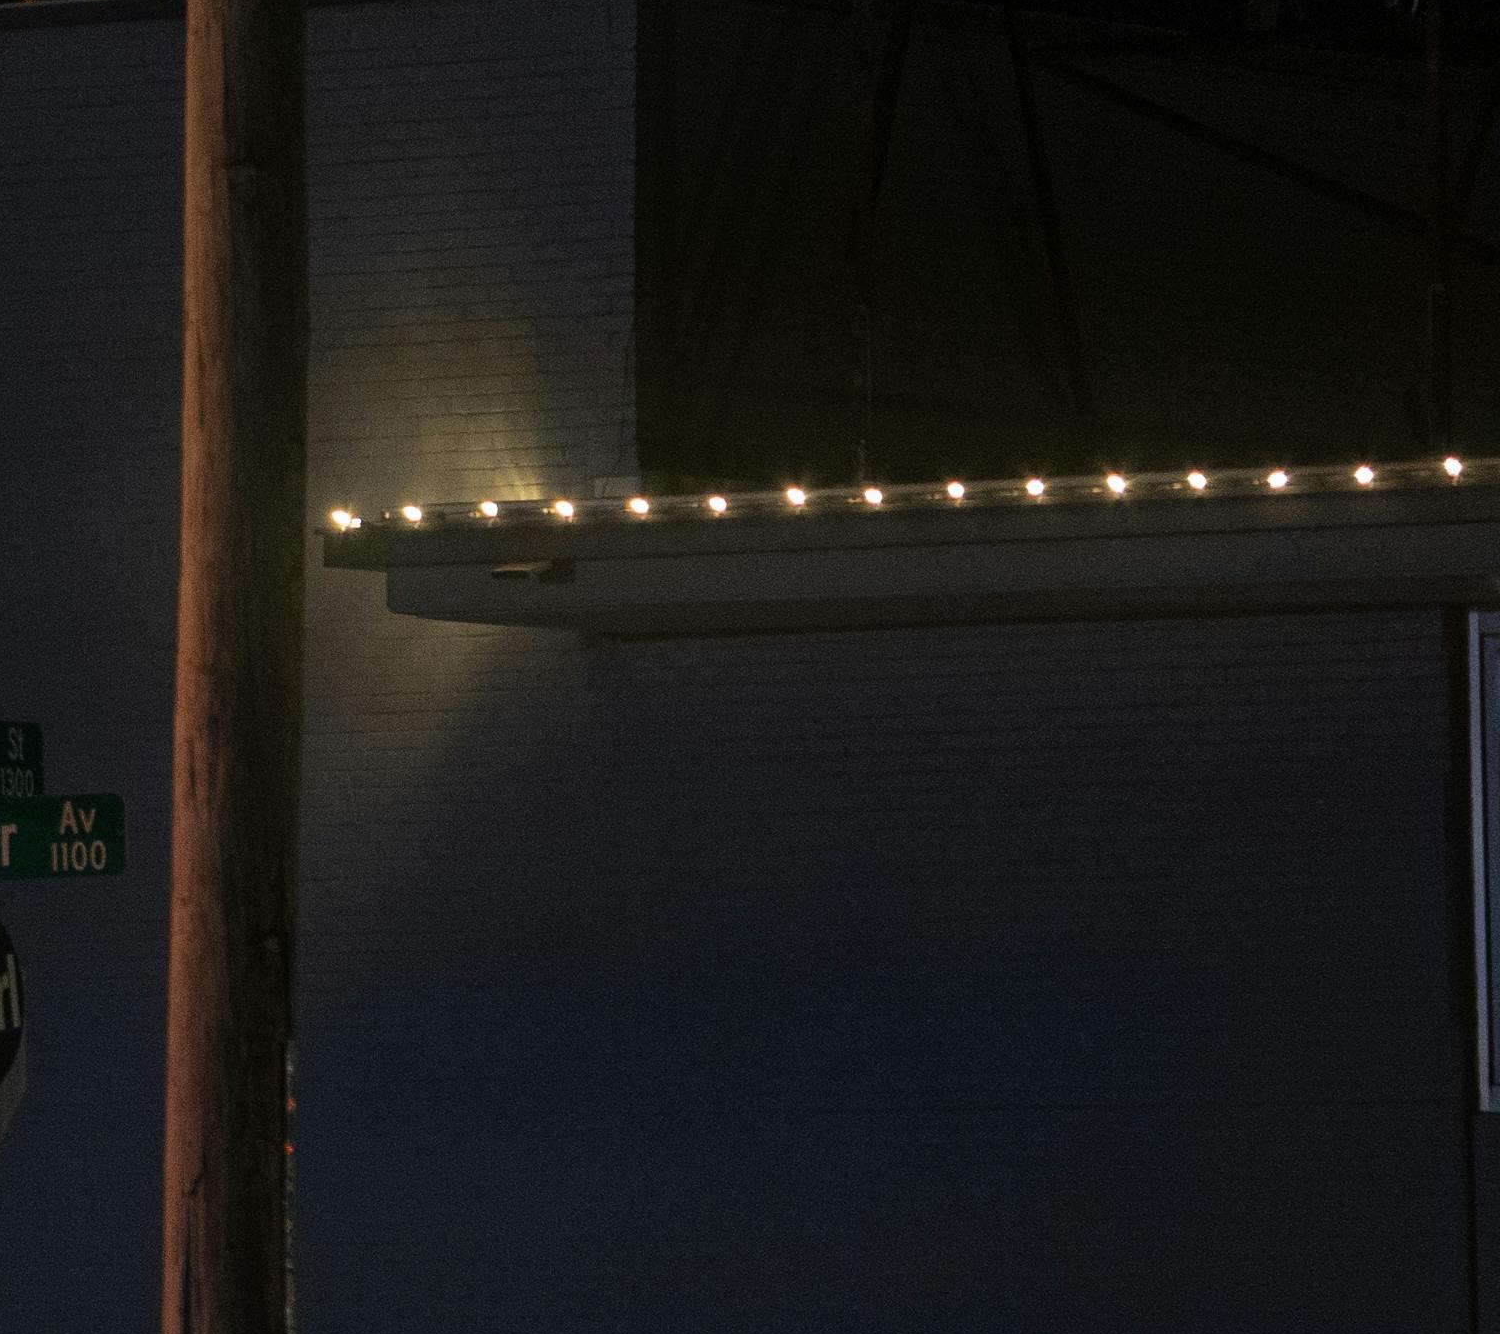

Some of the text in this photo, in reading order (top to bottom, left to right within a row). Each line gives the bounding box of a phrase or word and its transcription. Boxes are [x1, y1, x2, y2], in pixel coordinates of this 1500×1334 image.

[8, 727, 25, 761] St
[0, 767, 35, 797] 1300
[58, 800, 98, 835] Av
[50, 840, 108, 872] 1100
